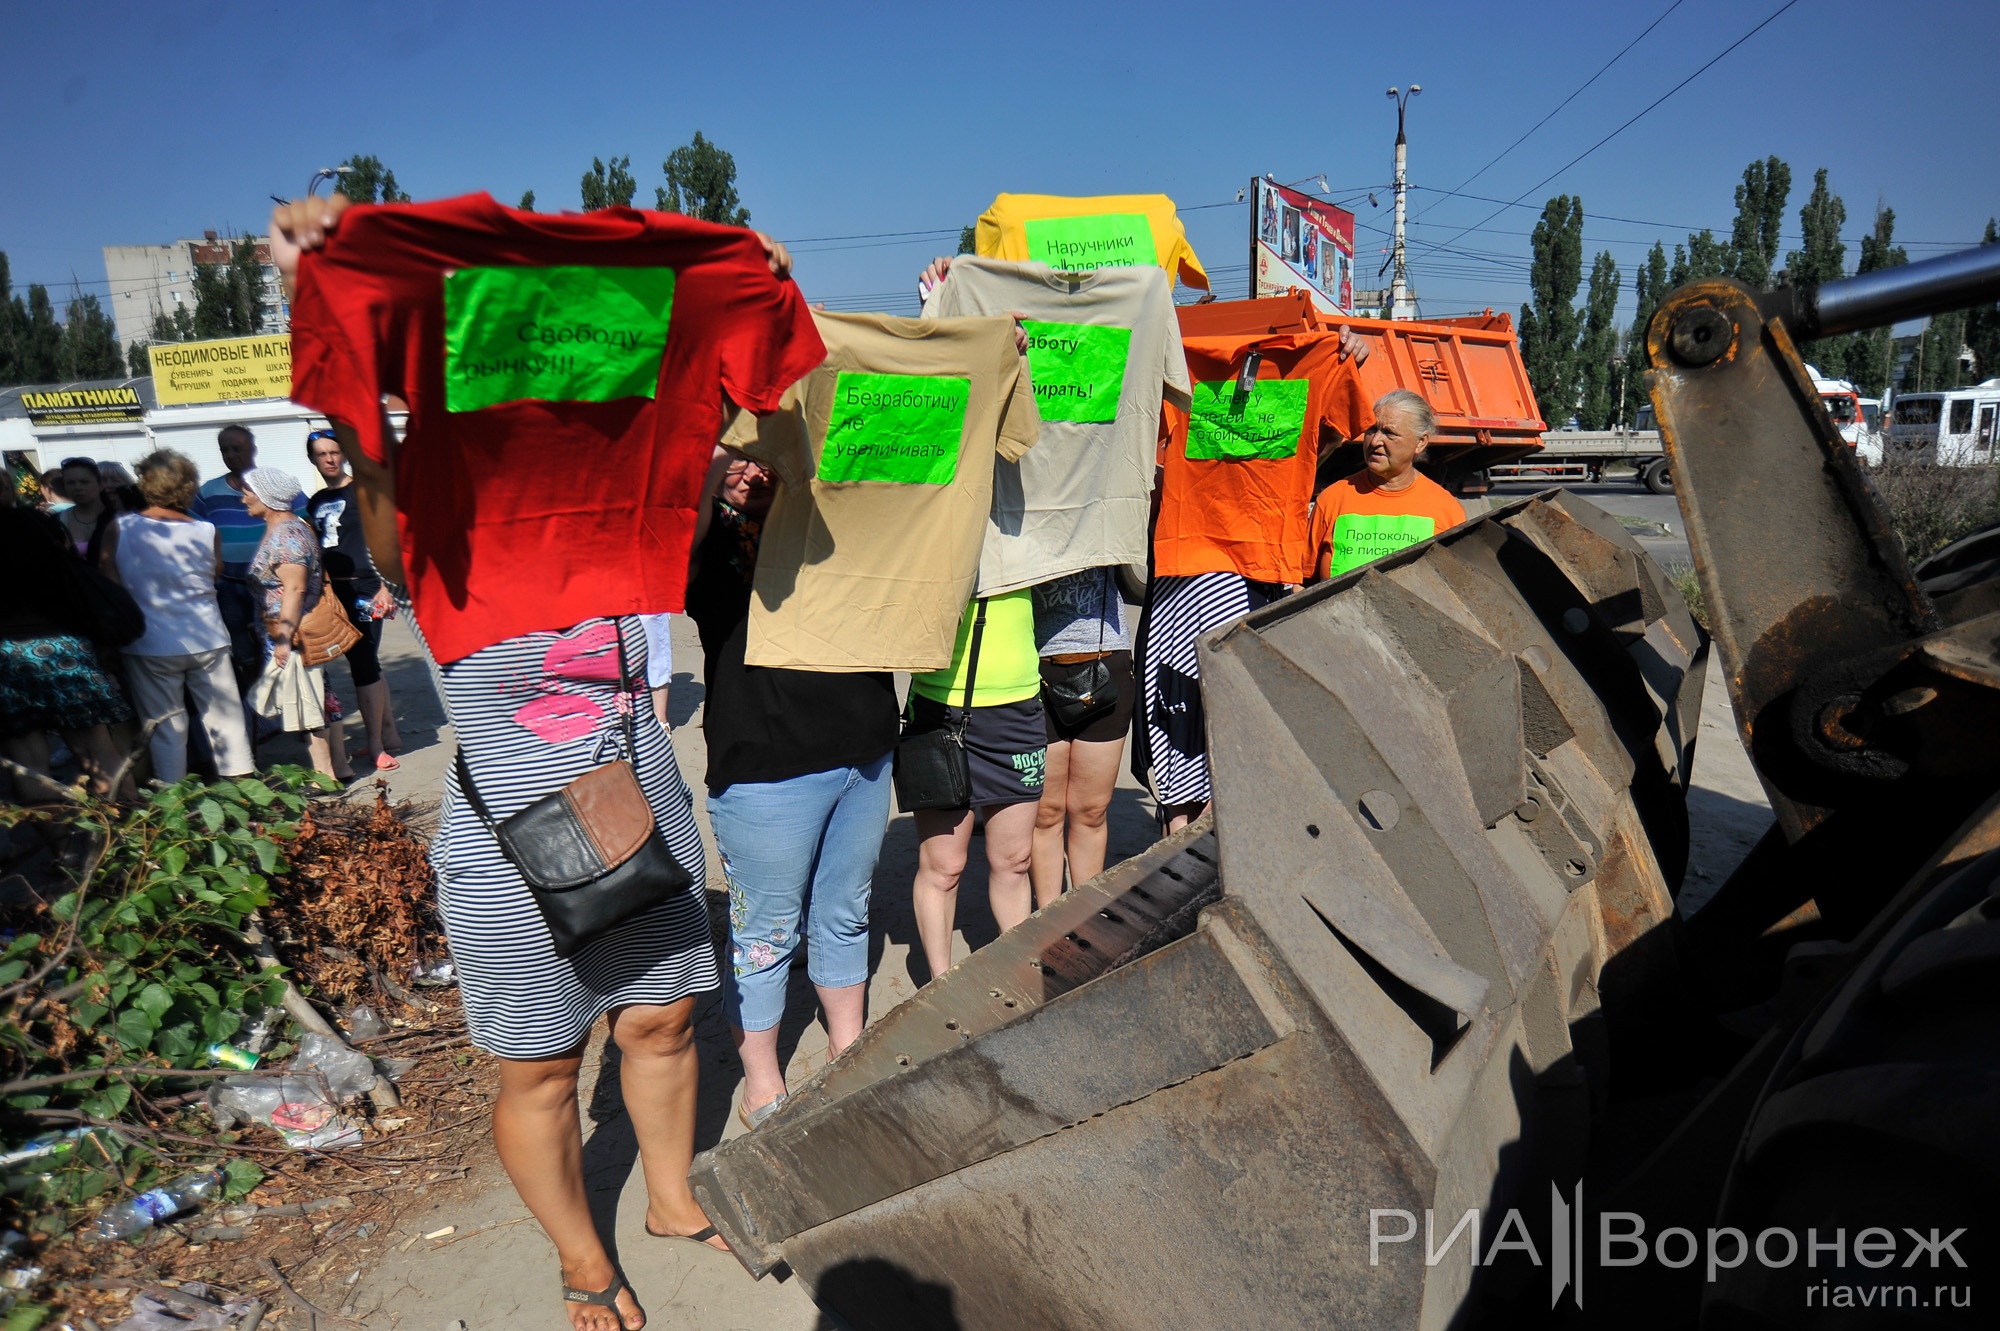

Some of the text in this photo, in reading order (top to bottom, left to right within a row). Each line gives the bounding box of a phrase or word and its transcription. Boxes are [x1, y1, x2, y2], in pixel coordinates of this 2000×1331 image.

[1047, 236, 1134, 256] Наручники
[517, 321, 644, 351] Свободу
[155, 345, 250, 367] НЕОДИМОВЫЕ
[171, 369, 214, 380] СУВЕНИРЫ
[222, 366, 246, 375] ЧАСЫ
[464, 355, 575, 385] рынку!!!
[175, 382, 211, 391] ИГРУШКИ
[221, 377, 259, 388] ПОДАРКИ
[21, 388, 138, 409] ПАМЯТНИКИ
[847, 386, 960, 412] Безработицу
[1211, 390, 1263, 407] Хлеб у
[842, 417, 864, 431] не
[1197, 412, 1275, 424] детей не
[834, 442, 945, 458] увеличивать
[1346, 529, 1420, 543] Протоколы
[1340, 546, 1401, 556] не писат
